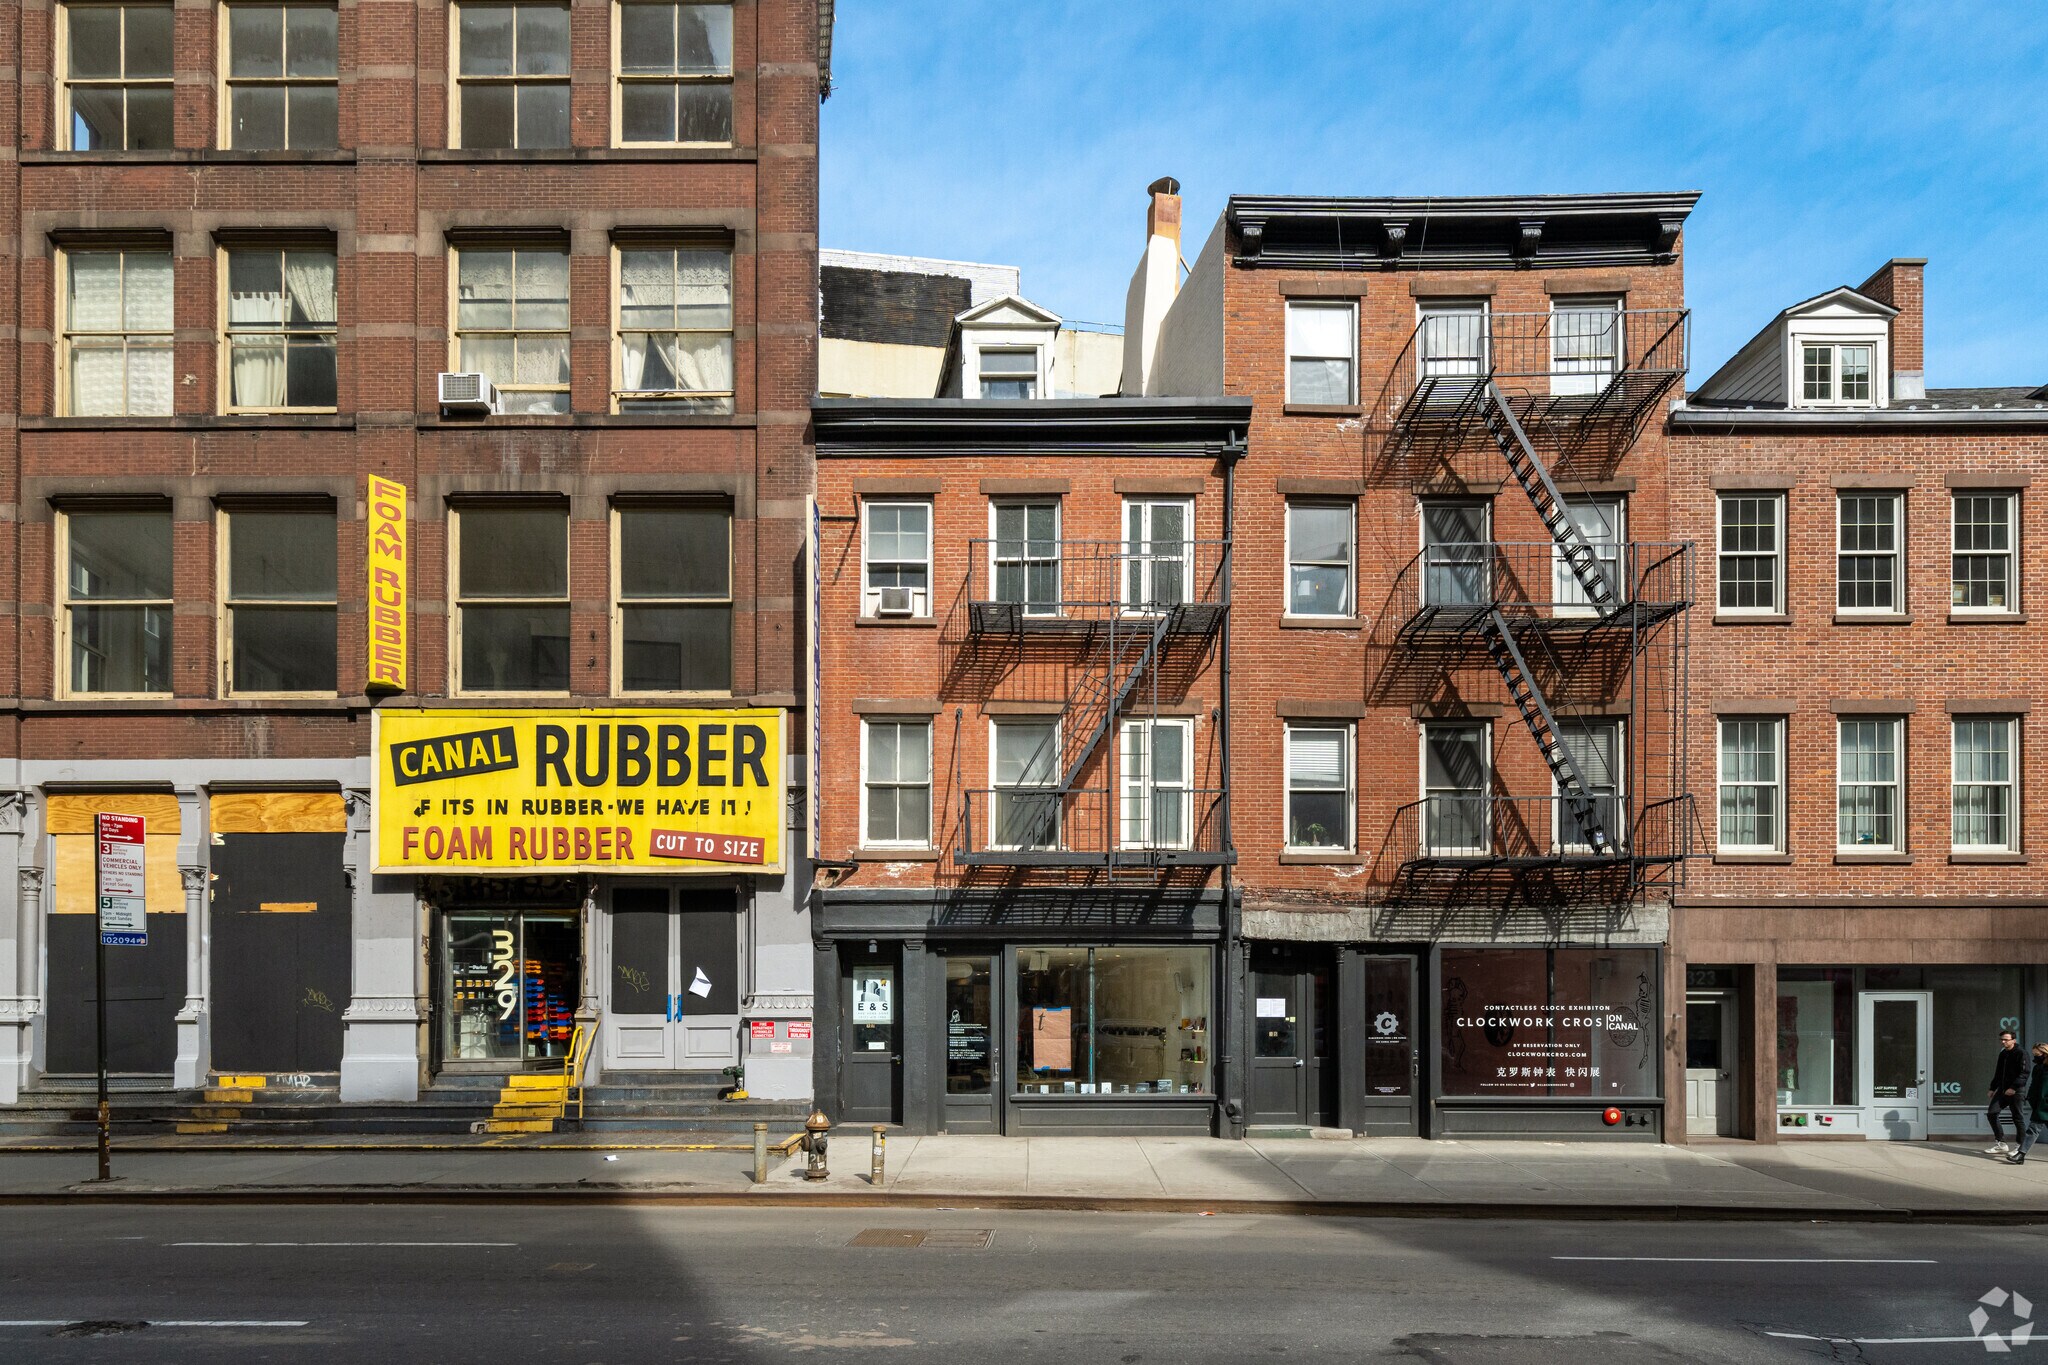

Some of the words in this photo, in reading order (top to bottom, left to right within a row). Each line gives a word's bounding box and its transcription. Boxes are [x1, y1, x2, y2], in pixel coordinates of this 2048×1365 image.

[374, 480, 402, 560] FOAM
[374, 567, 402, 684] RUBBER
[399, 734, 512, 777] CANAL
[536, 724, 770, 787] RUBBER
[442, 799, 474, 815] ITS
[488, 799, 508, 815] IN
[102, 844, 110, 854] 3
[402, 826, 493, 860] FOAM
[510, 826, 634, 860] RUBBER
[656, 834, 686, 850] CUT
[695, 838, 714, 853] TO
[724, 840, 758, 858] SIZE
[103, 898, 110, 908] 5
[492, 930, 516, 1020] 329
[1381, 1018, 1392, 1029] C
[1456, 1018, 1554, 1027] CLOCKWORK
[1562, 1018, 1602, 1027] CROS
[1496, 1066, 1556, 1077] 克罗斯钟表
[1565, 1066, 1600, 1077] 快闪展
